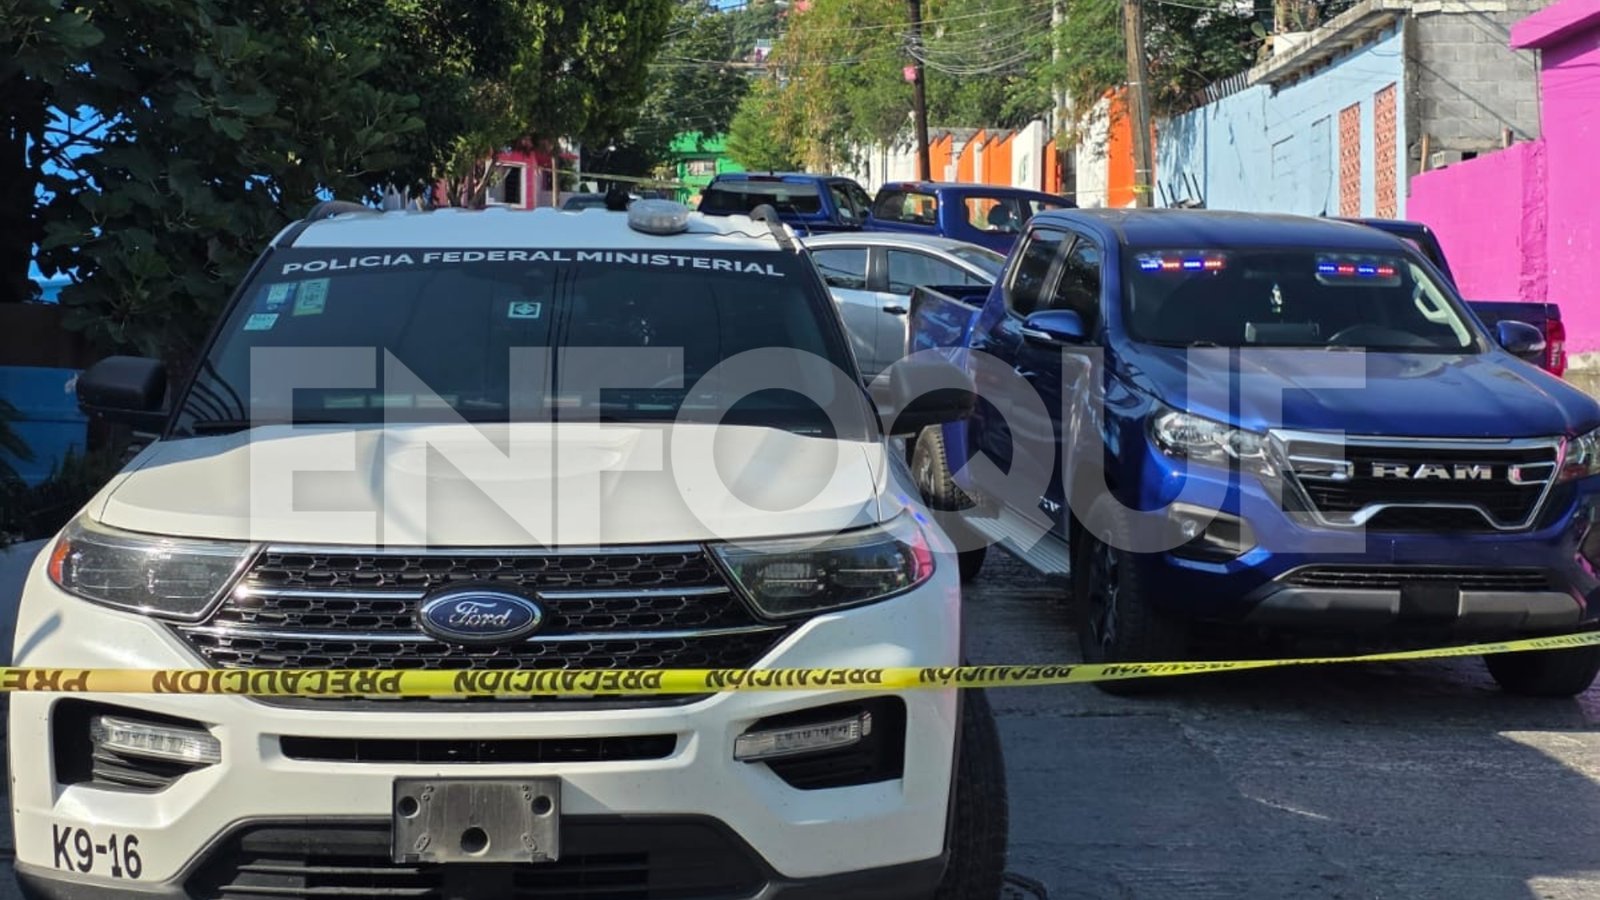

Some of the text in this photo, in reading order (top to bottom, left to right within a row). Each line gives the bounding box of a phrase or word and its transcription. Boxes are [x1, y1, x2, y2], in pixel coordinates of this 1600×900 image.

[281, 250, 785, 277] POLICIA FEDERAL MINISTERIAL
[1371, 462, 1492, 480] RAM
[448, 601, 513, 626] Ford
[53, 824, 142, 879] K9-16
